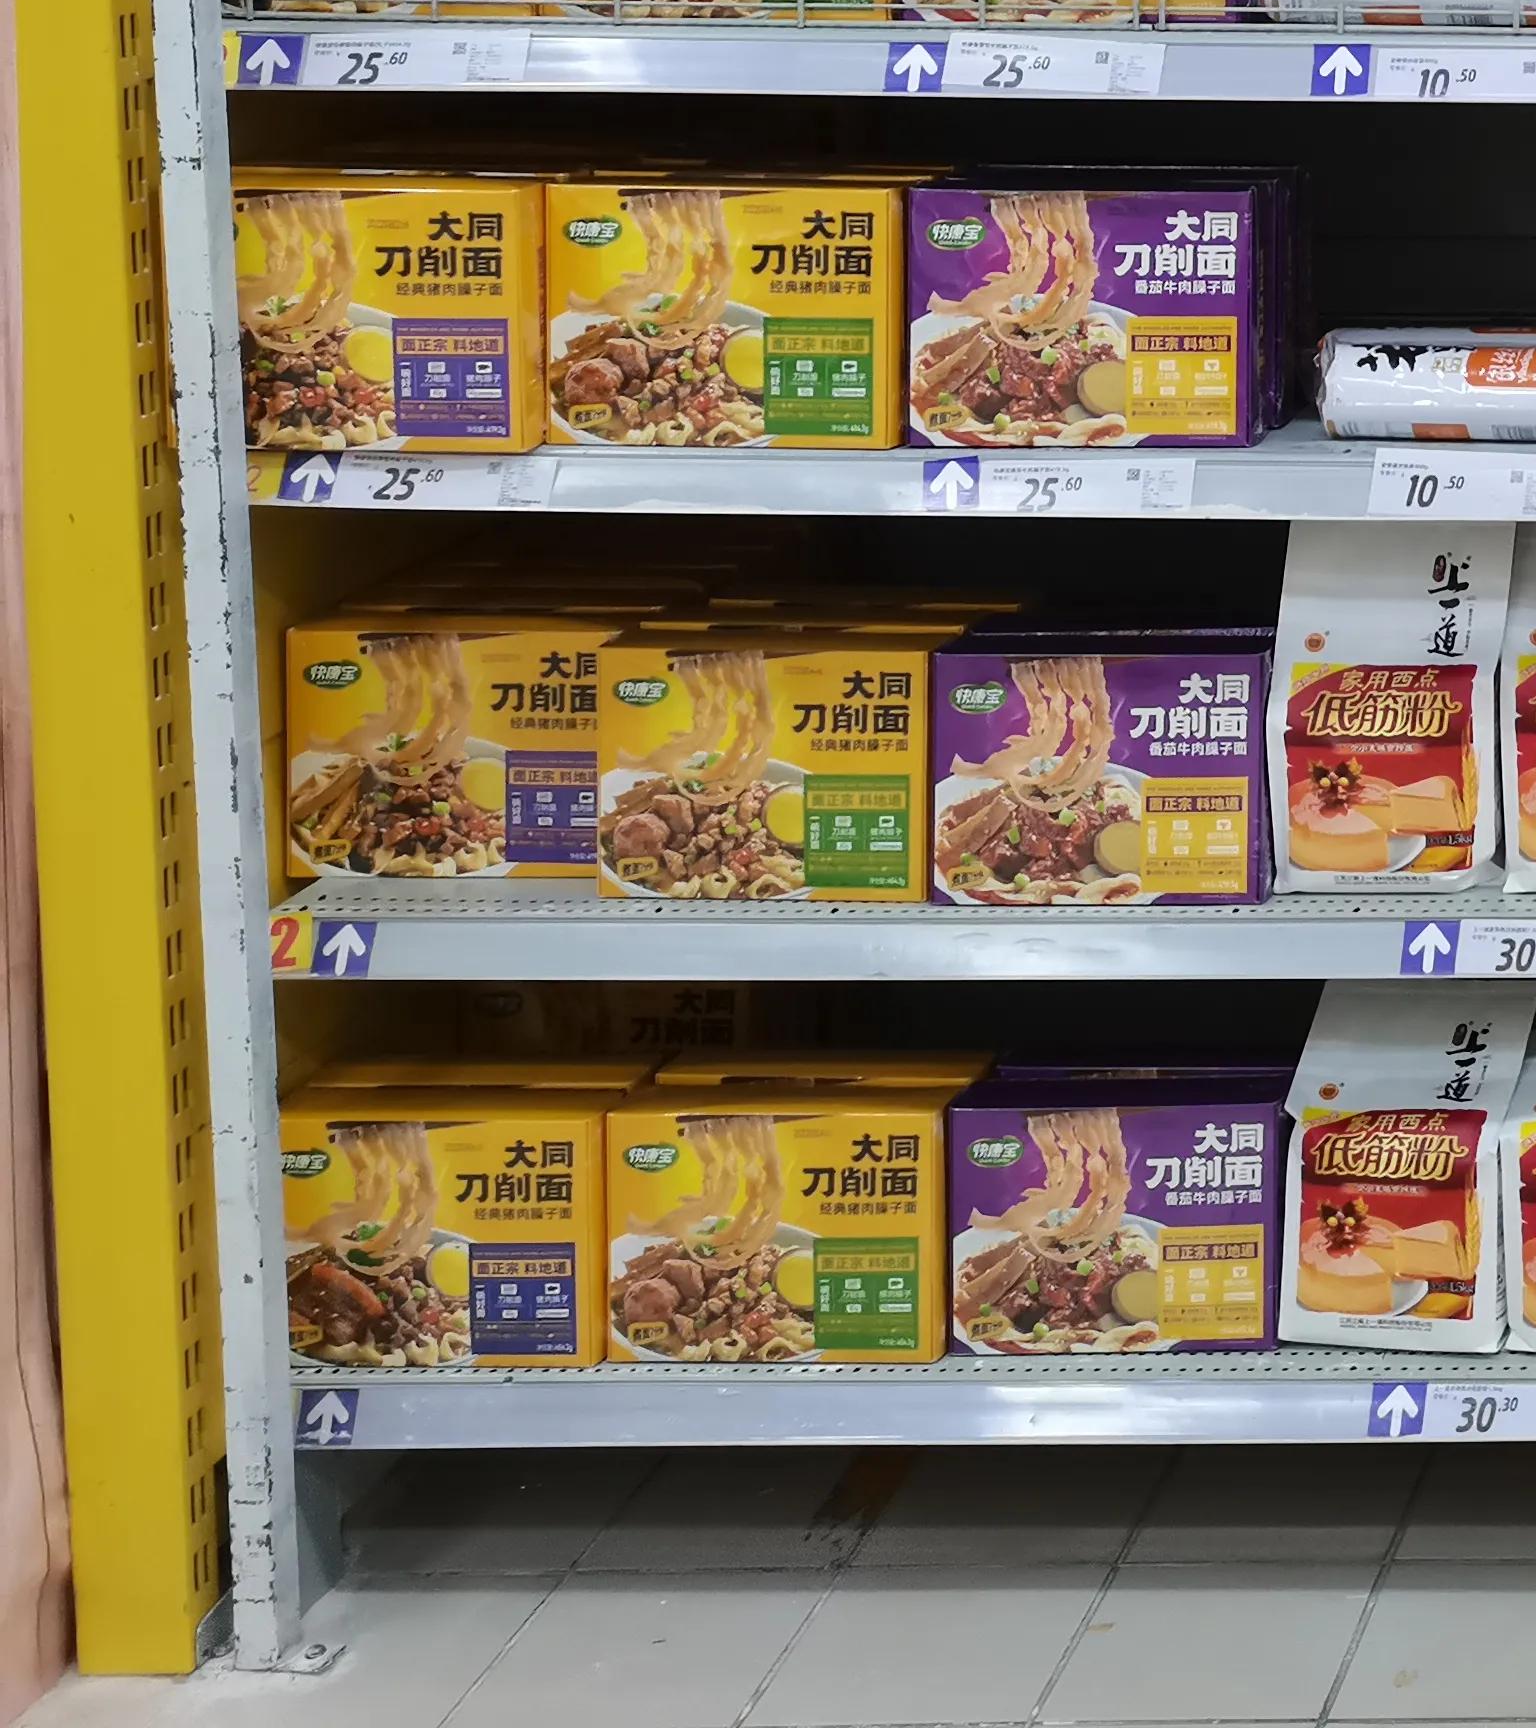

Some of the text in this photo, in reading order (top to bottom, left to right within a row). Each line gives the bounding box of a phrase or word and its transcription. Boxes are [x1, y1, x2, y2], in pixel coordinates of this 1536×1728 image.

[428, 211, 503, 241] 大同
[931, 224, 983, 242] 快康宝
[374, 246, 503, 278] 刀削面
[751, 245, 872, 277] 刀削面
[1113, 244, 1237, 278] 刀削面
[842, 671, 912, 700] 大同
[1180, 674, 1250, 704] 大同
[1340, 668, 1438, 691] 家用西点
[1130, 707, 1248, 739] 刀削面
[1305, 692, 1461, 737] 低筋粉
[271, 918, 299, 968] 2
[1312, 1133, 1467, 1180] 低筋粉
[455, 1173, 573, 1204] 刀削面
[802, 1167, 918, 1199] 刀削面
